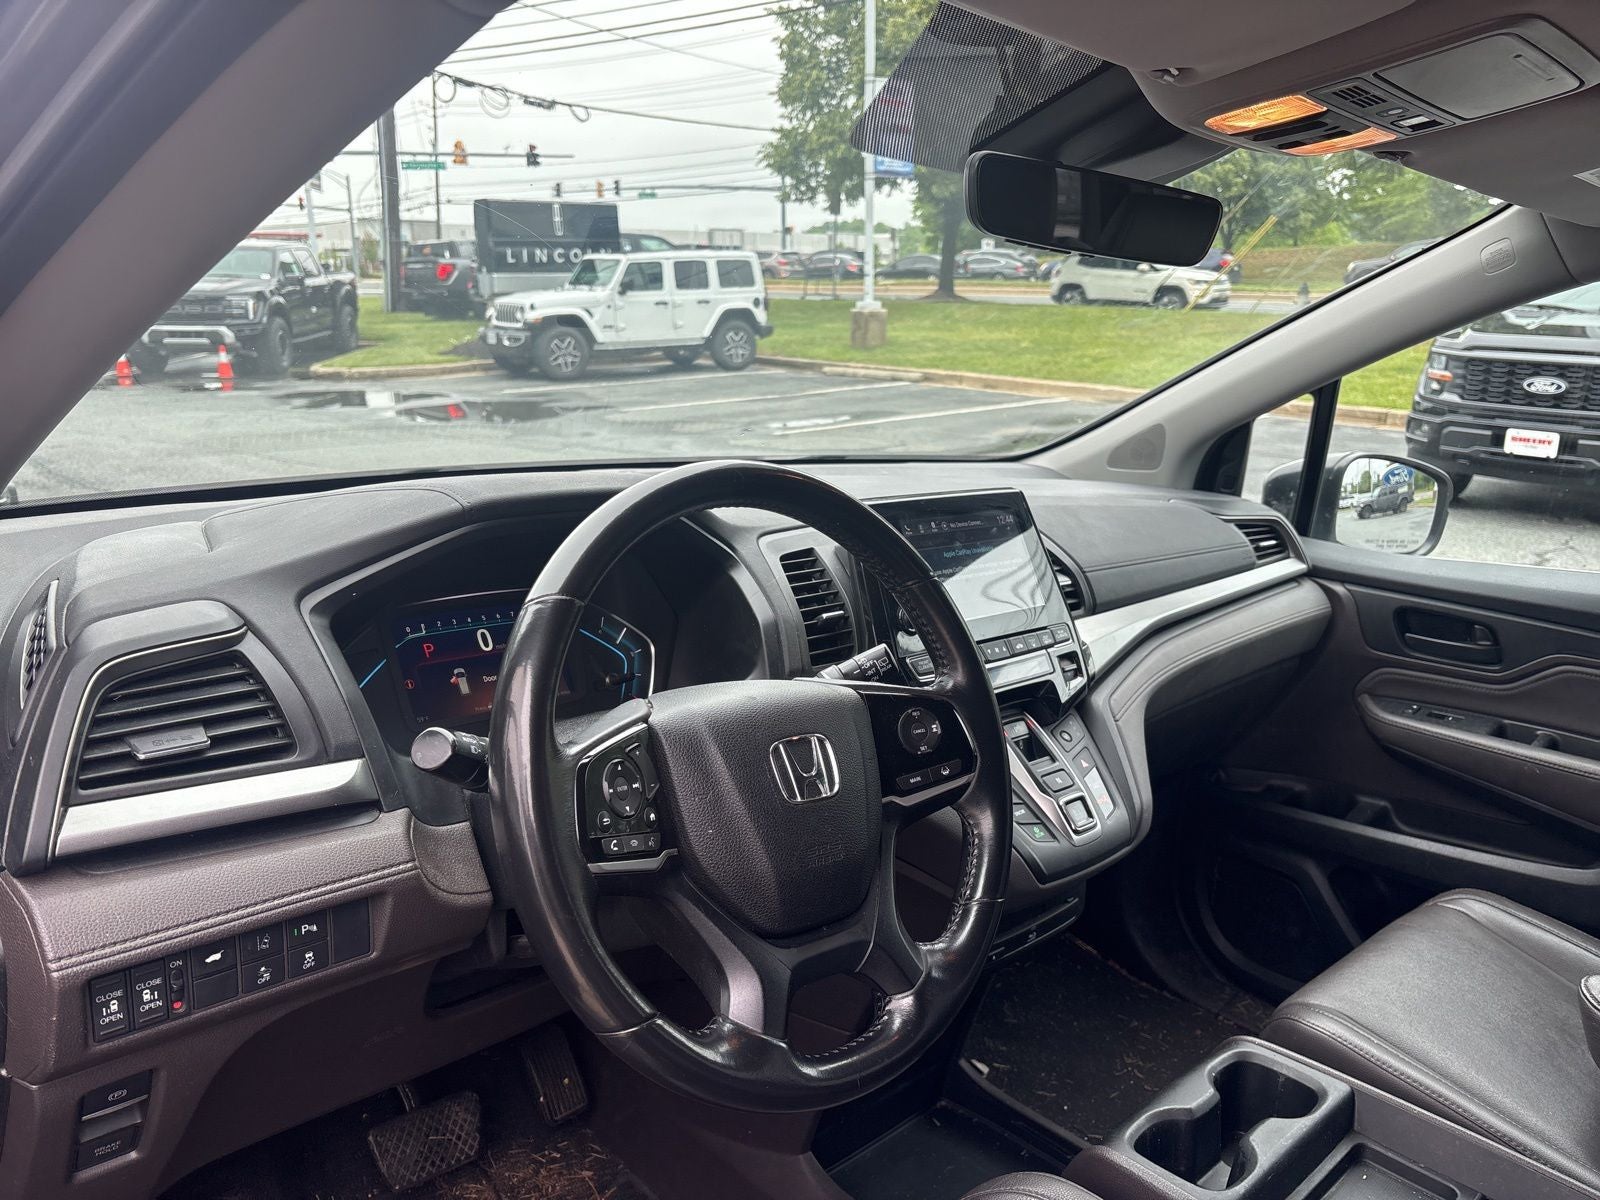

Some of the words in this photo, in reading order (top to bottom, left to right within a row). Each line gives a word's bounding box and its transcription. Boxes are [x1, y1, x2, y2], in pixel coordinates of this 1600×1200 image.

[476, 628, 494, 652] 0
[423, 643, 435, 658] P
[302, 924, 309, 935] P
[169, 959, 183, 968] ON
[303, 960, 316, 970] OFF
[136, 977, 163, 991] CLOSE
[257, 975, 271, 985] OFF
[95, 989, 124, 1003] CLOSE
[140, 999, 163, 1012] OPEN
[100, 1012, 124, 1025] OPEN
